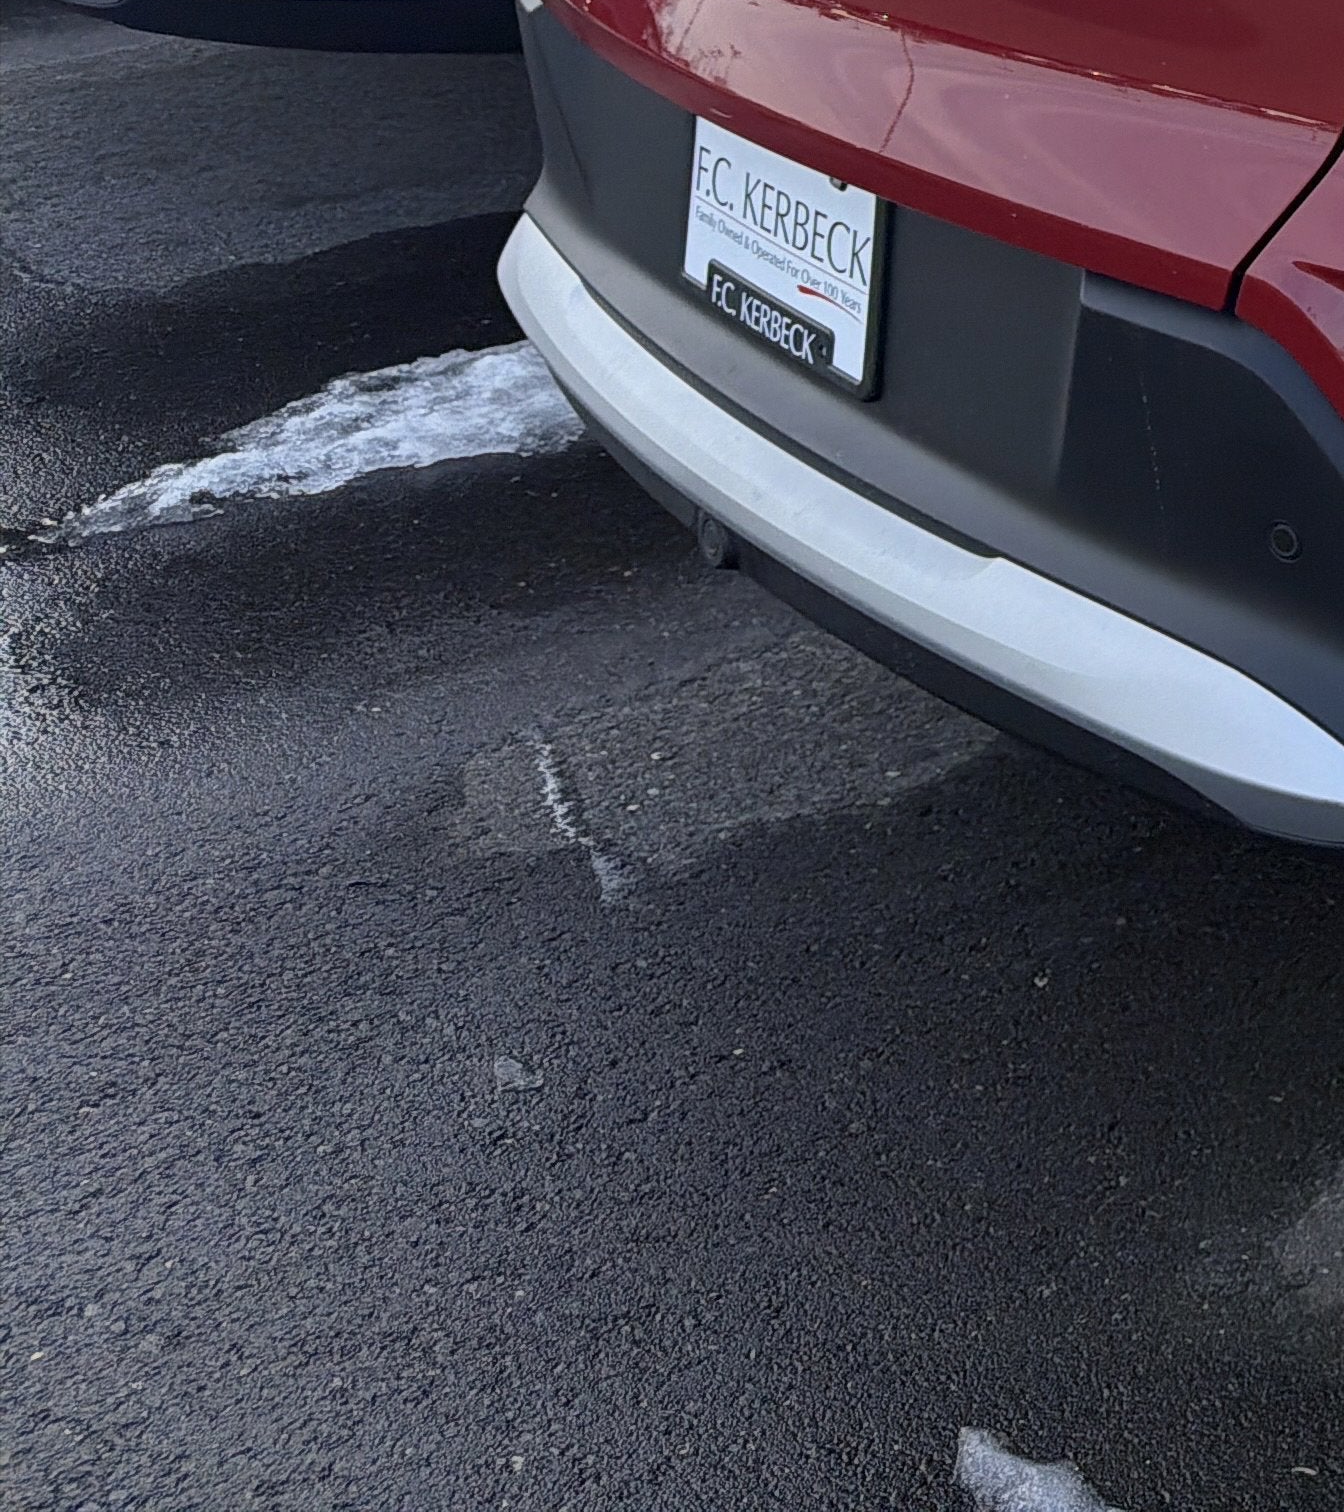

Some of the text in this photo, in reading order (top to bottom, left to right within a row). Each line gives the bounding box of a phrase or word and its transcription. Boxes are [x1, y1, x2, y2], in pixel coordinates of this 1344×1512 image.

[695, 205, 717, 232] Family
[717, 218, 744, 246] Owned
[751, 240, 786, 272] Operated
[786, 261, 800, 279] For
[800, 268, 823, 290] Over
[823, 279, 839, 299] 100
[840, 288, 863, 315] Years
[696, 145, 871, 287] F.C. KERBECK
[710, 273, 817, 365] F.C. KERBECK
